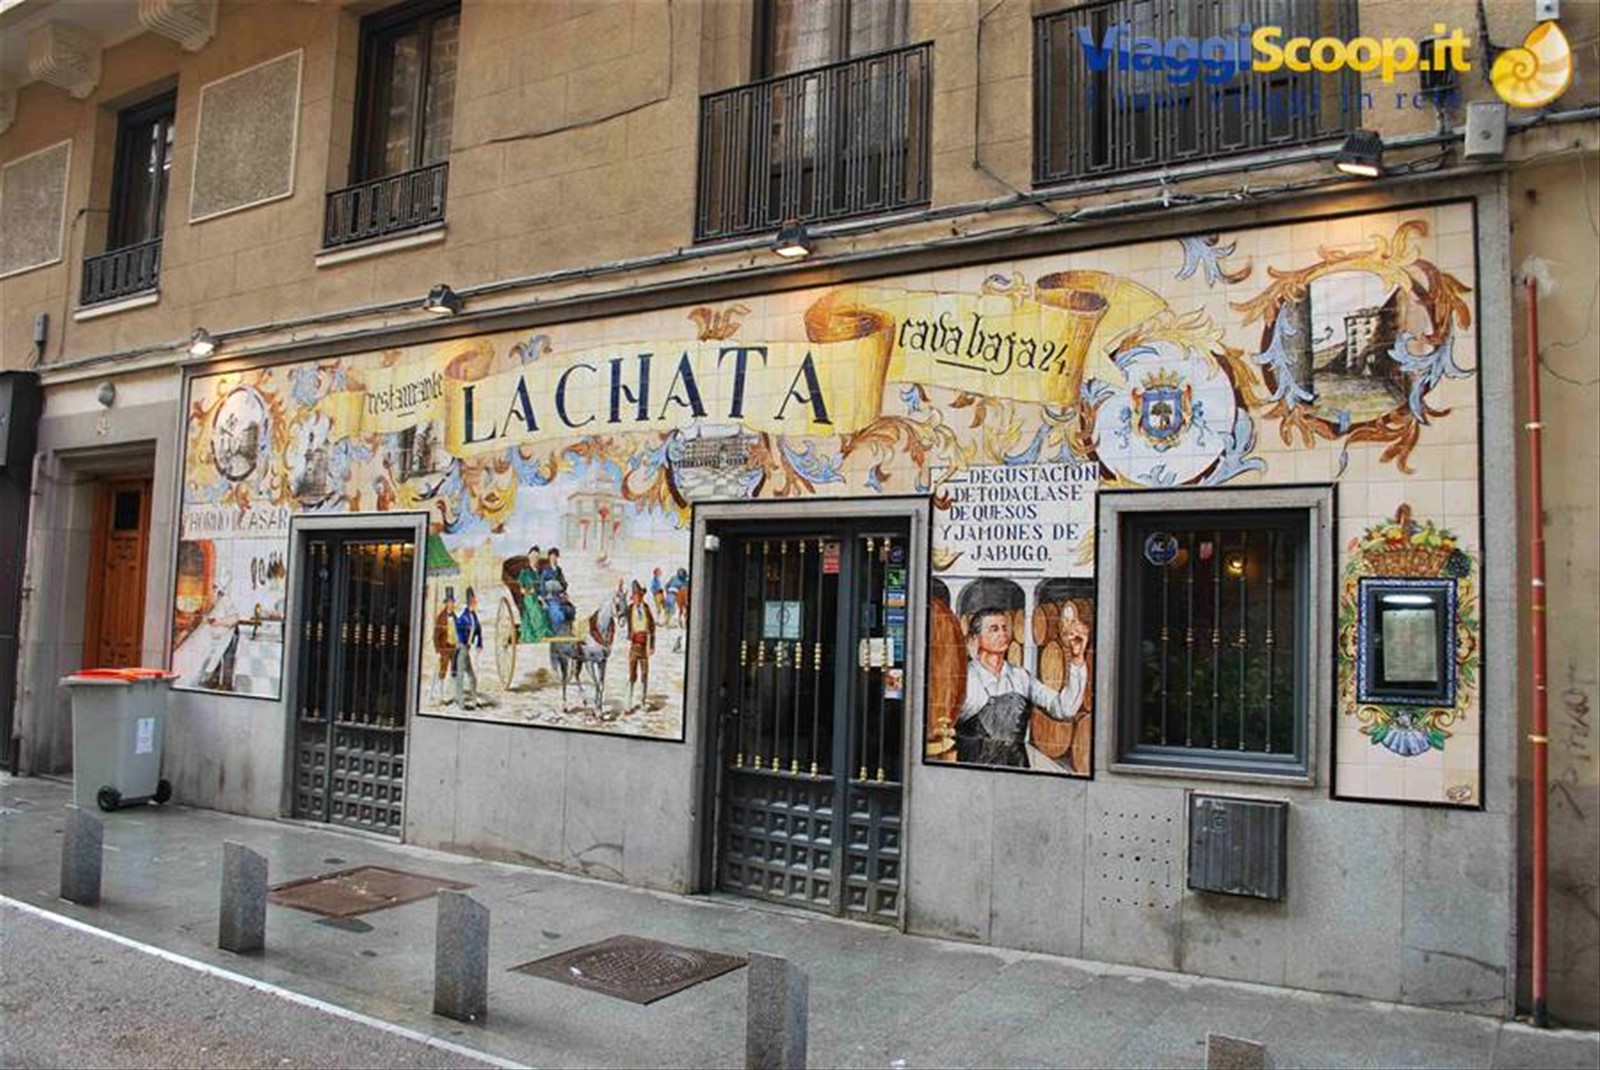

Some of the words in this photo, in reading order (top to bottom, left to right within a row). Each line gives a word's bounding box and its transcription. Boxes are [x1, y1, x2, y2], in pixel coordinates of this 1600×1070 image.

[462, 375, 540, 445] LA
[554, 346, 834, 429] CHATA
[977, 485, 1020, 501] TODA
[1022, 484, 1083, 501] CLASE
[950, 504, 970, 521] DE
[972, 503, 1037, 522] QUESOS
[940, 525, 952, 541] Y
[954, 523, 1043, 541] JAMONES
[1053, 523, 1079, 540] DE
